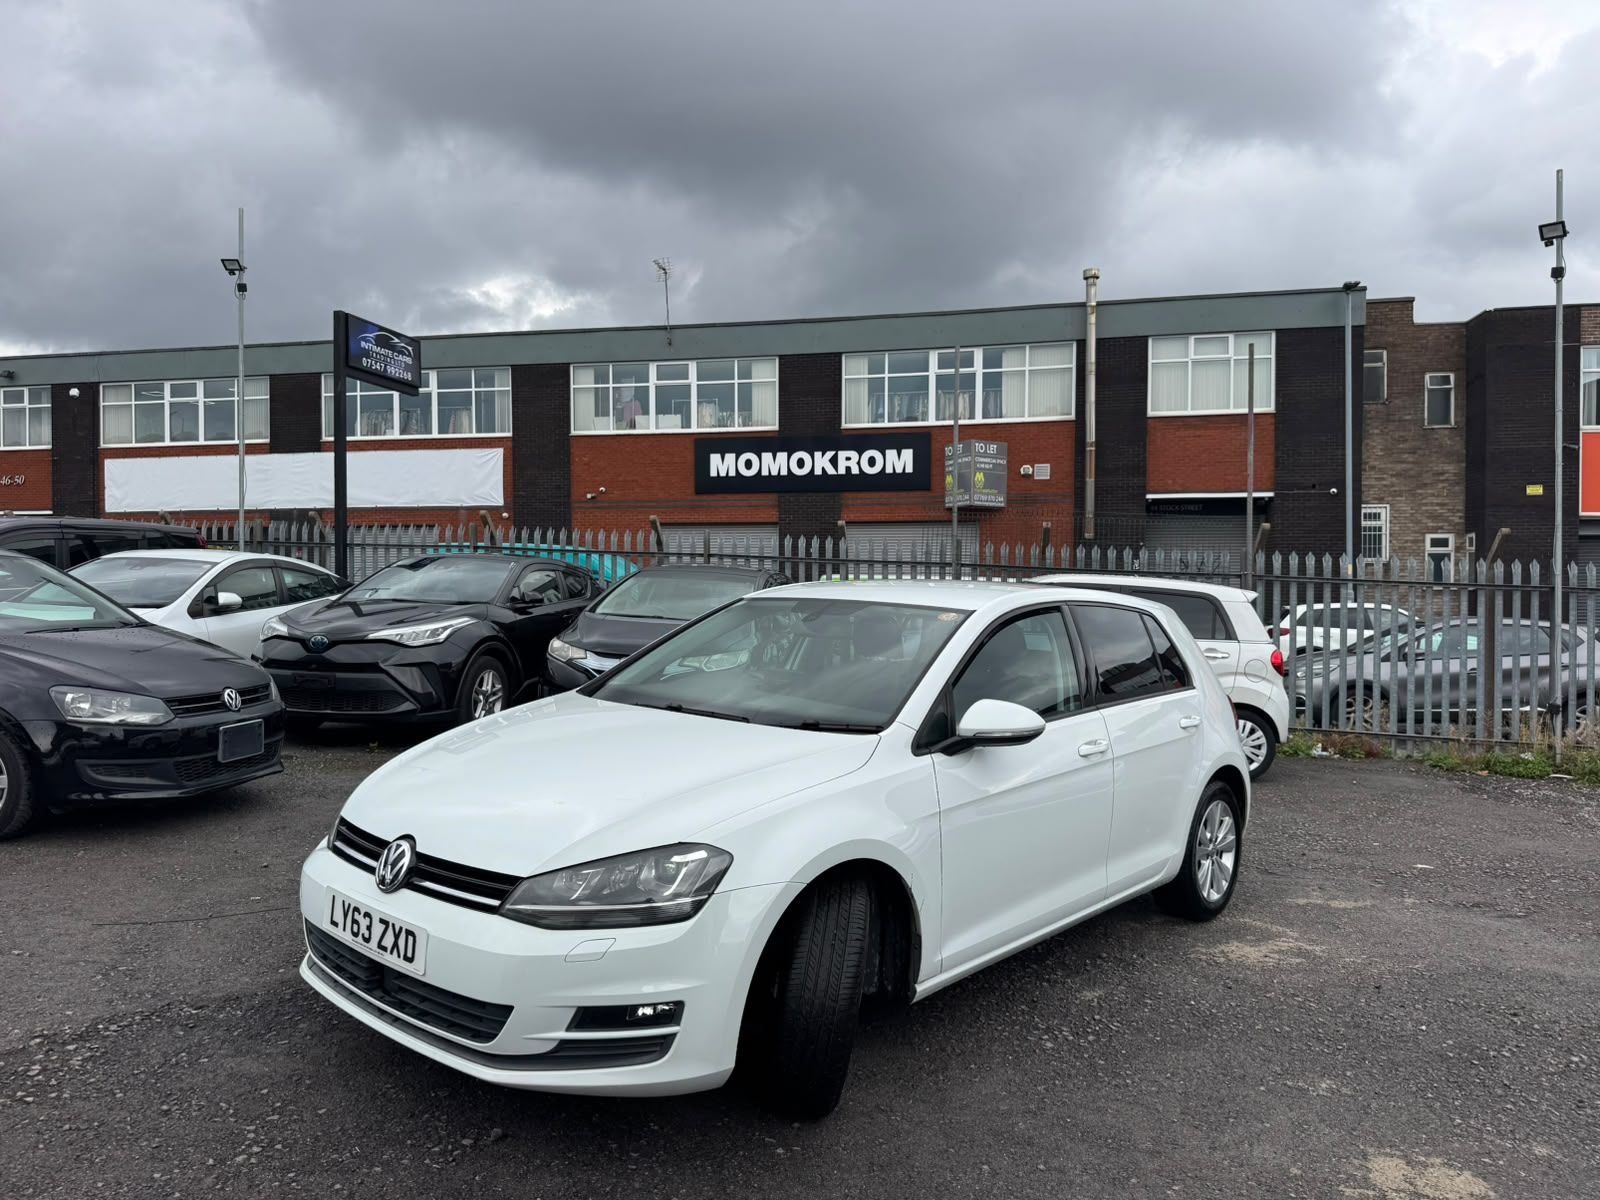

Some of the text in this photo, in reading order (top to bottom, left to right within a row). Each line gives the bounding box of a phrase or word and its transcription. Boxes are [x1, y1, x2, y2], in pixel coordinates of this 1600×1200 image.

[360, 341, 413, 364] INTIMATE CARS
[369, 352, 394, 364] TRADING
[362, 357, 412, 381] 07547 992268
[945, 447, 953, 456] TO
[975, 442, 997, 454] TO LET
[709, 449, 914, 477] MOMOKROM
[330, 894, 417, 964] LY63 ZXD
